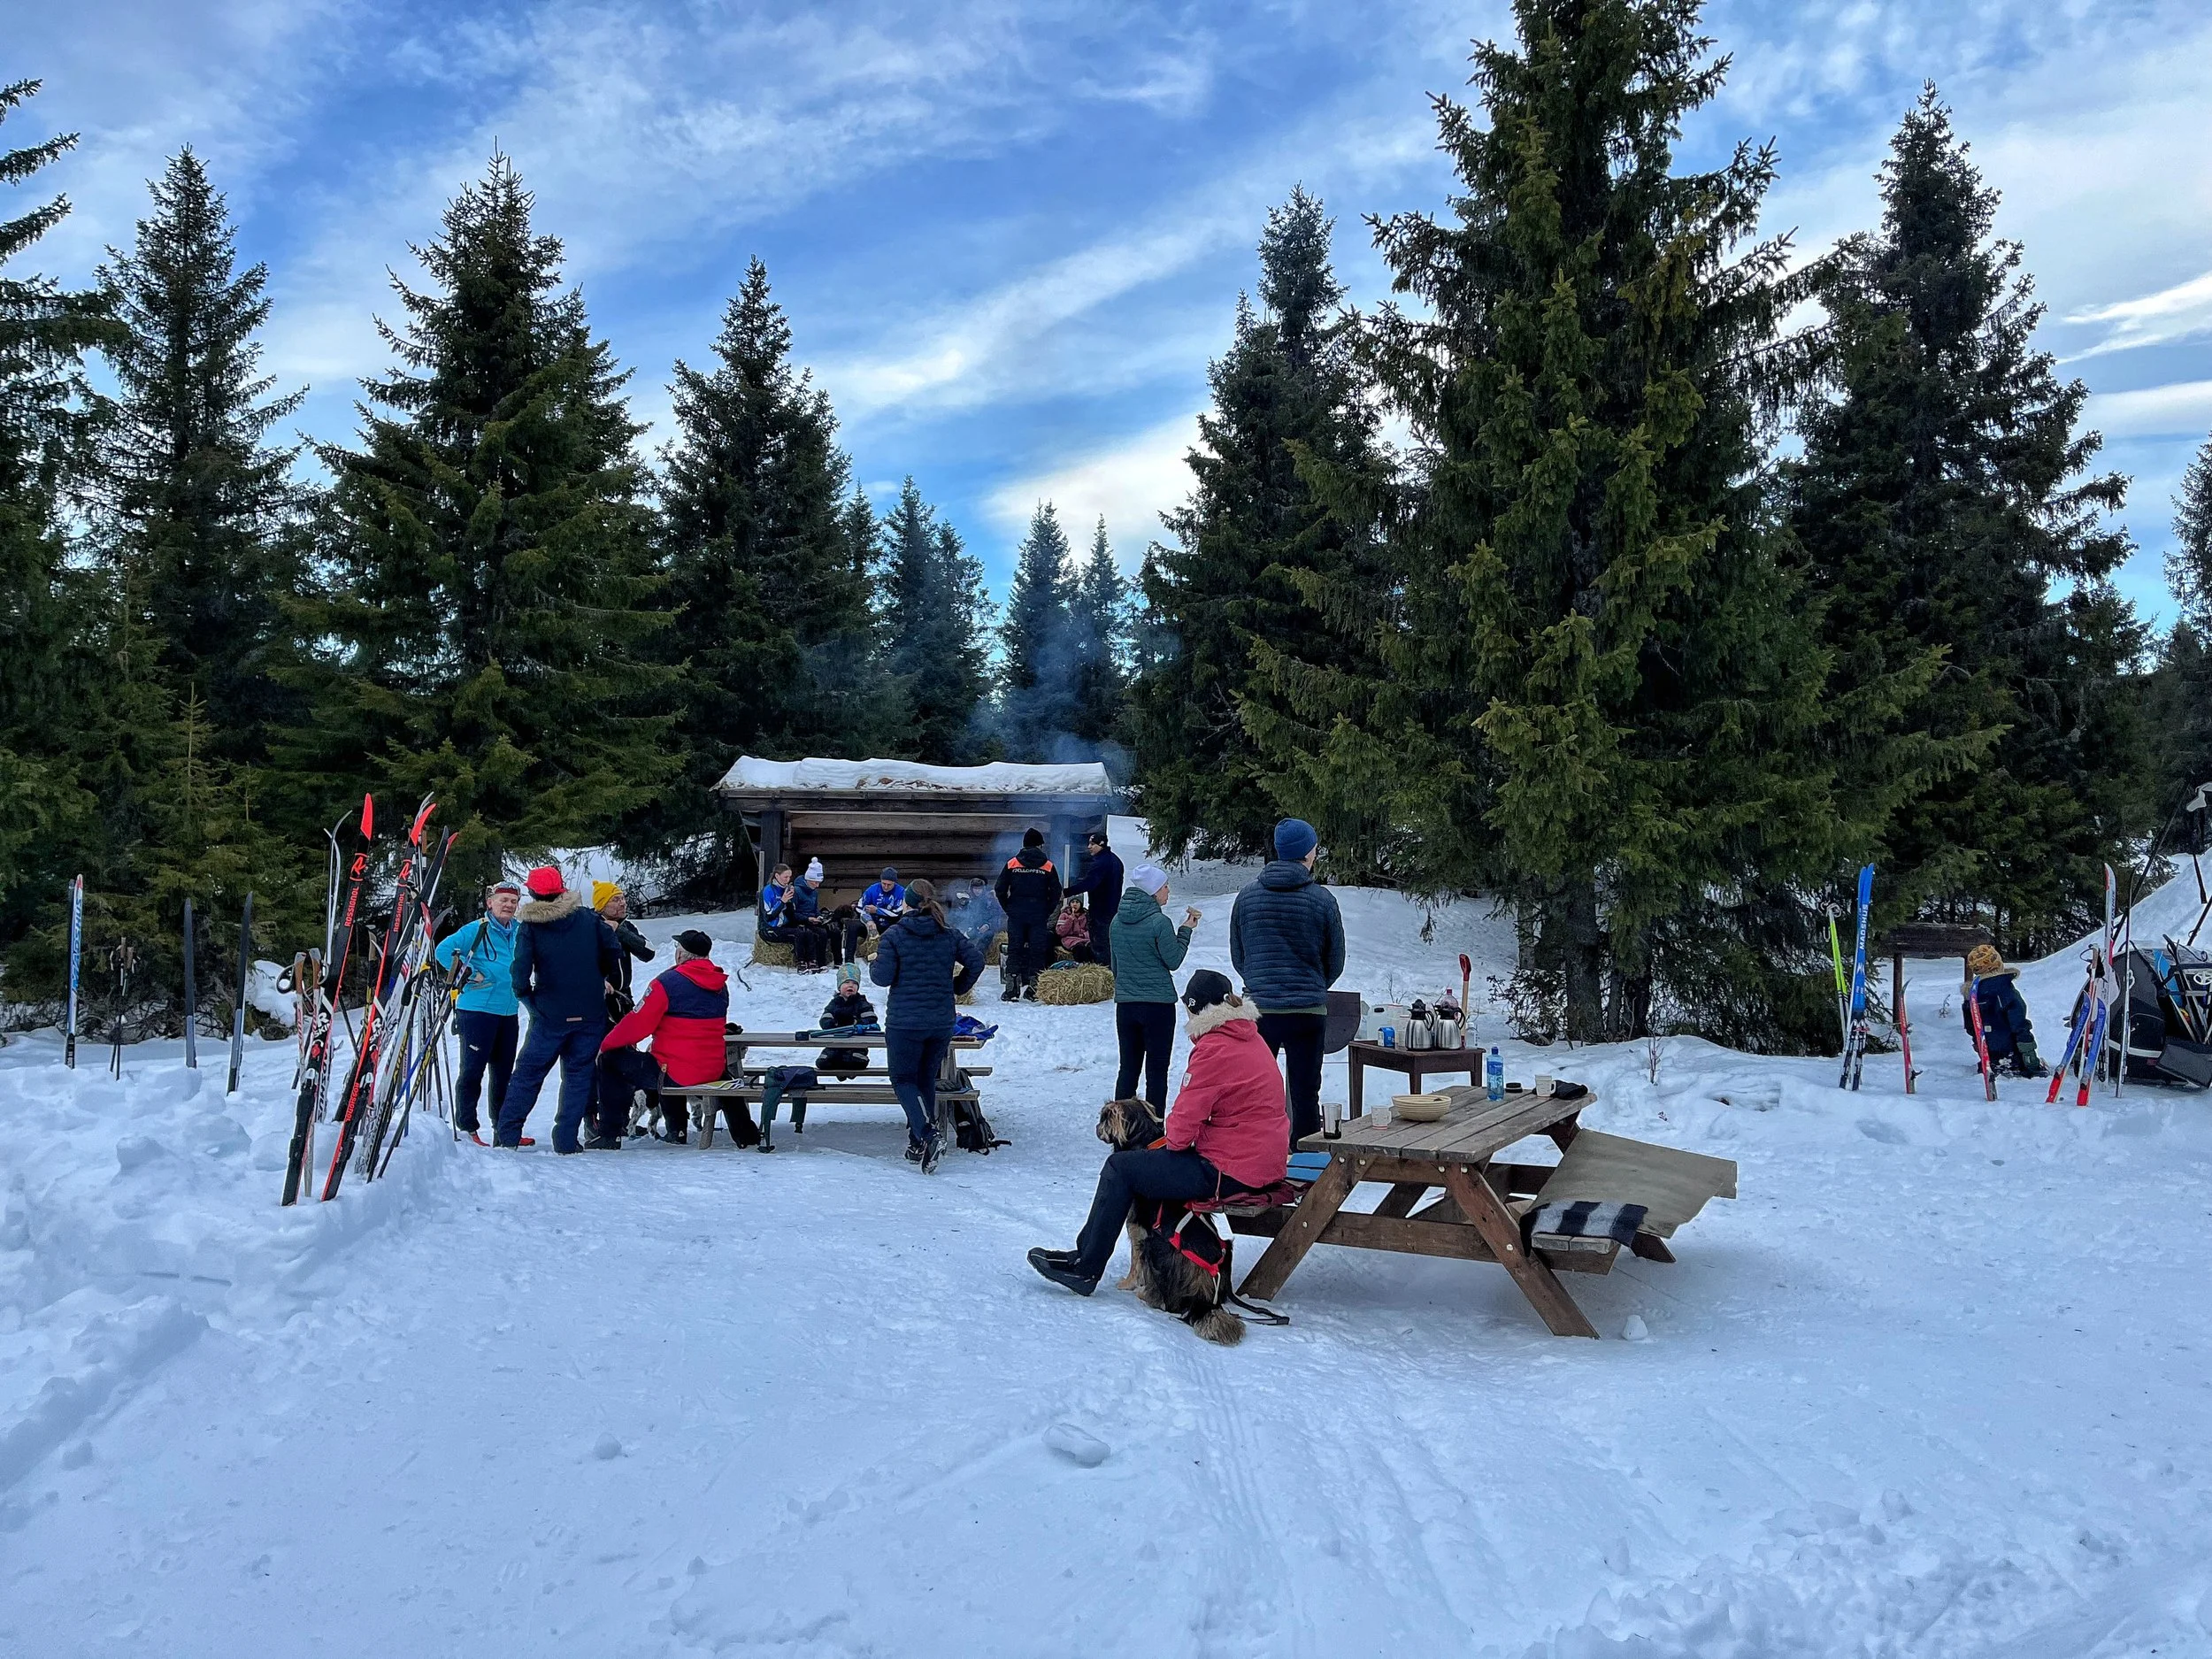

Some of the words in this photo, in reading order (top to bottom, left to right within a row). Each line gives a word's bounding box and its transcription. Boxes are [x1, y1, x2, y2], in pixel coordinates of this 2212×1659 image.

[344, 887, 359, 927] ROSSIGNOL
[394, 892, 405, 933] ROSSIGNOL
[1860, 903, 1869, 950] MADSHUS
[73, 898, 82, 991] MADSHUS
[345, 1082, 360, 1122] ROSSIGNOL
